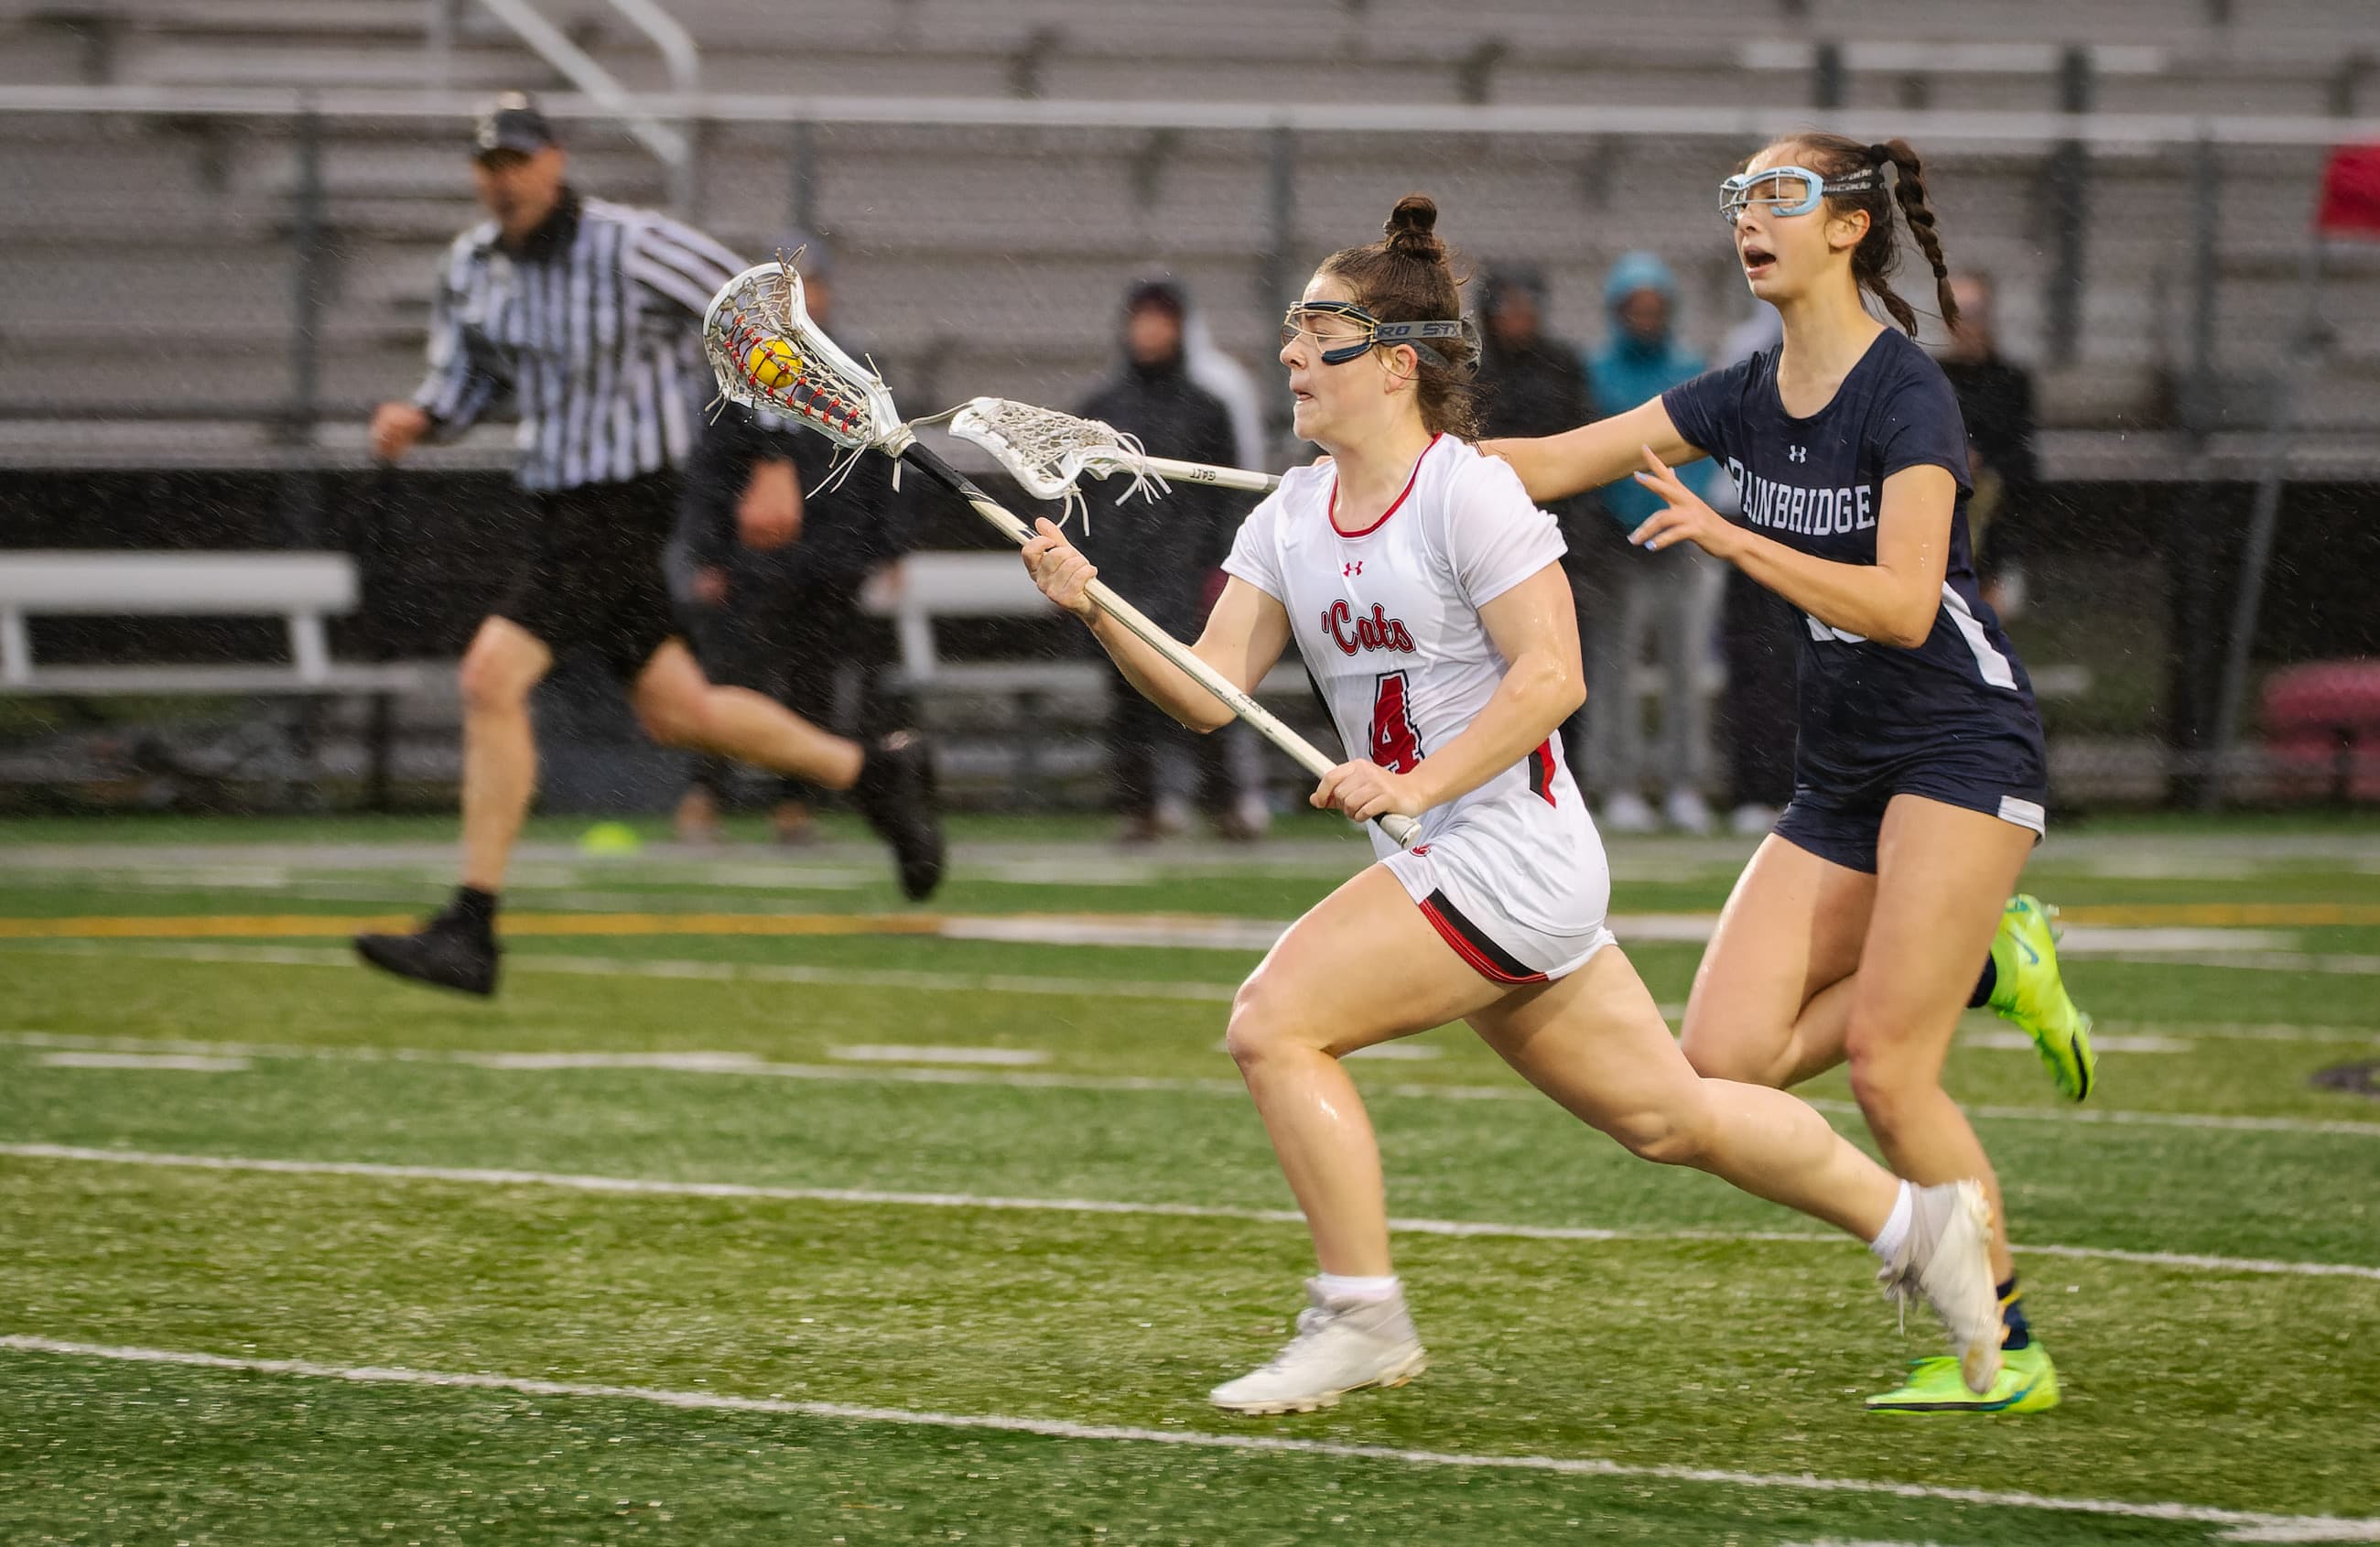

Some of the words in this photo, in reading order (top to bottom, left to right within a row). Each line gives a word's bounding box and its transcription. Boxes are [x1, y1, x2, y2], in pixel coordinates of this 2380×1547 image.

[1376, 326, 1411, 337] RO
[1423, 322, 1460, 338] STX
[1189, 468, 1217, 481] GAIT
[1368, 669, 1425, 774] 4
